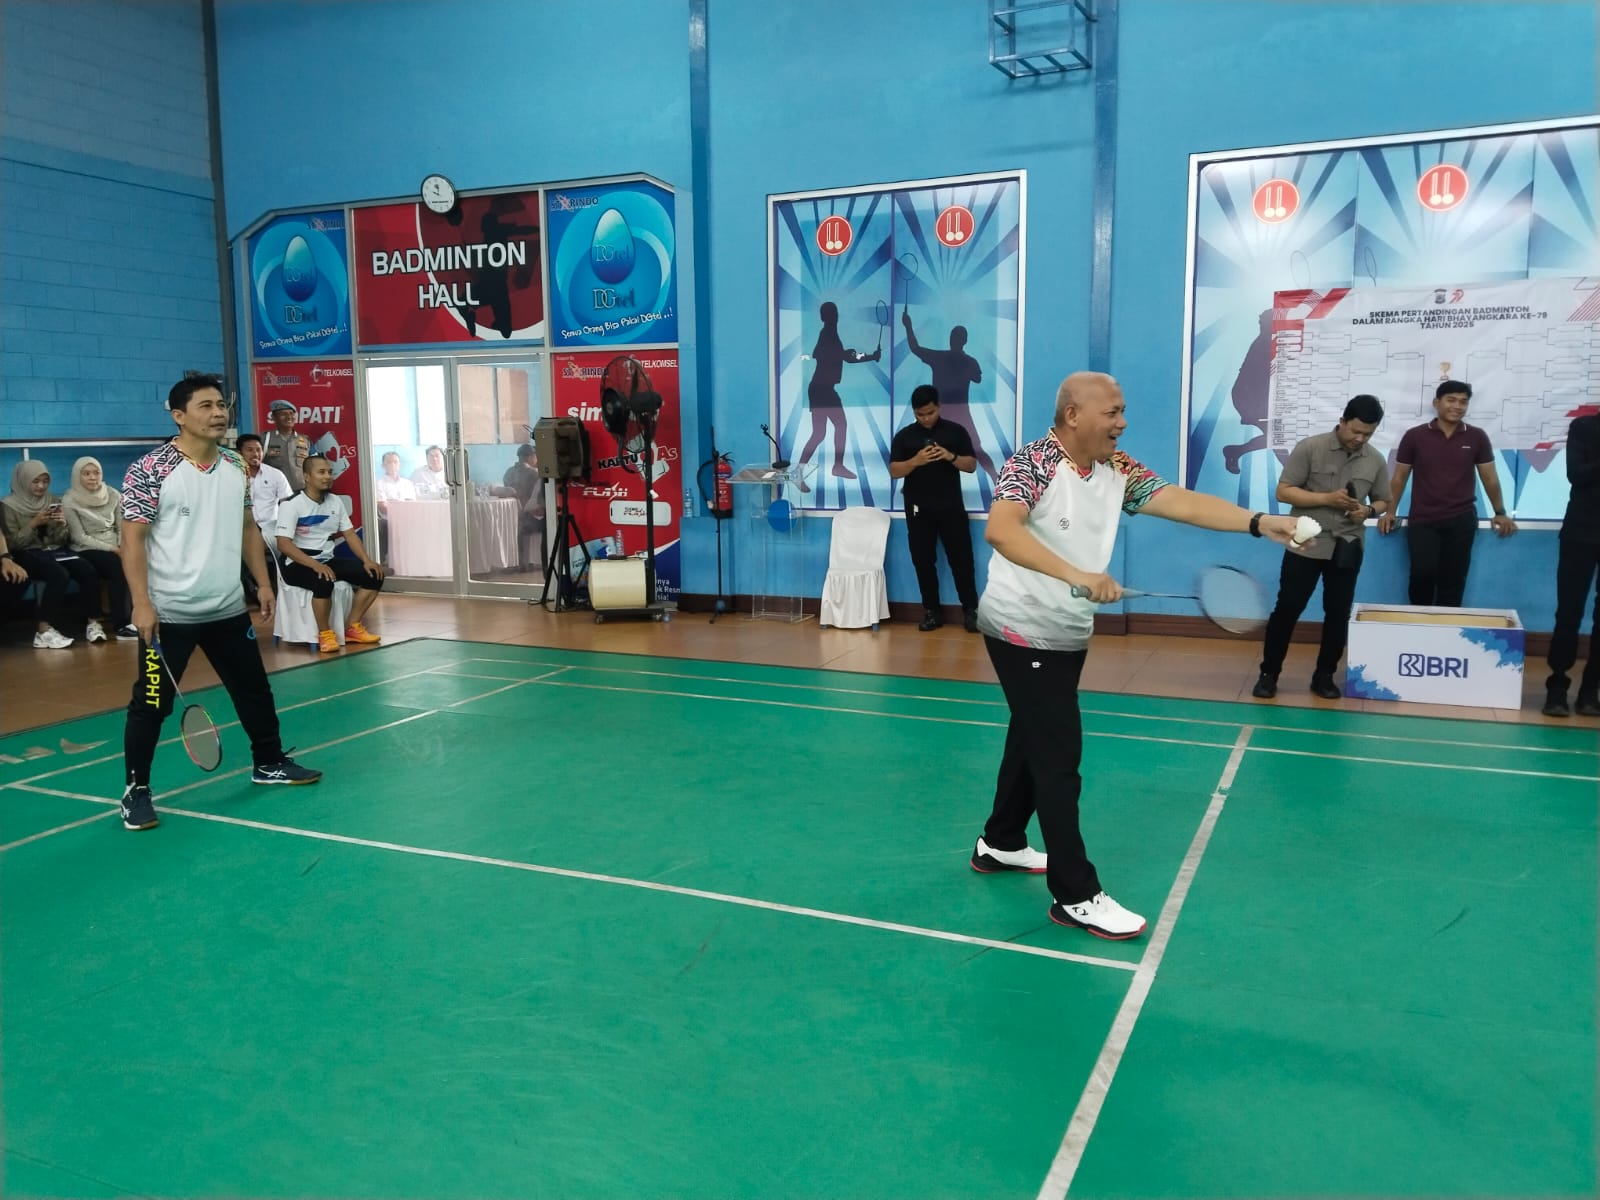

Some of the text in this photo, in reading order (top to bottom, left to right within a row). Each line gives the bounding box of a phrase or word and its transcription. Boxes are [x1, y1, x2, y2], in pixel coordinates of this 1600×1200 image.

[372, 240, 526, 276] BADMINTON
[418, 282, 480, 309] HALL
[1369, 305, 1530, 318] SKEMA PERTANDINGAN BADMINTON
[1385, 316, 1423, 325] RANGKA
[1424, 315, 1446, 324] HARI
[1447, 313, 1519, 323] BHAYANGKARA
[1420, 321, 1475, 330] TAHUN 2025
[583, 325, 605, 337] Orang
[605, 322, 620, 331] Bisa
[641, 359, 678, 369] TELKOMSEL
[323, 368, 354, 377] TELKOMSEL
[146, 633, 160, 708] RAPHT
[1426, 655, 1469, 679] BRI
